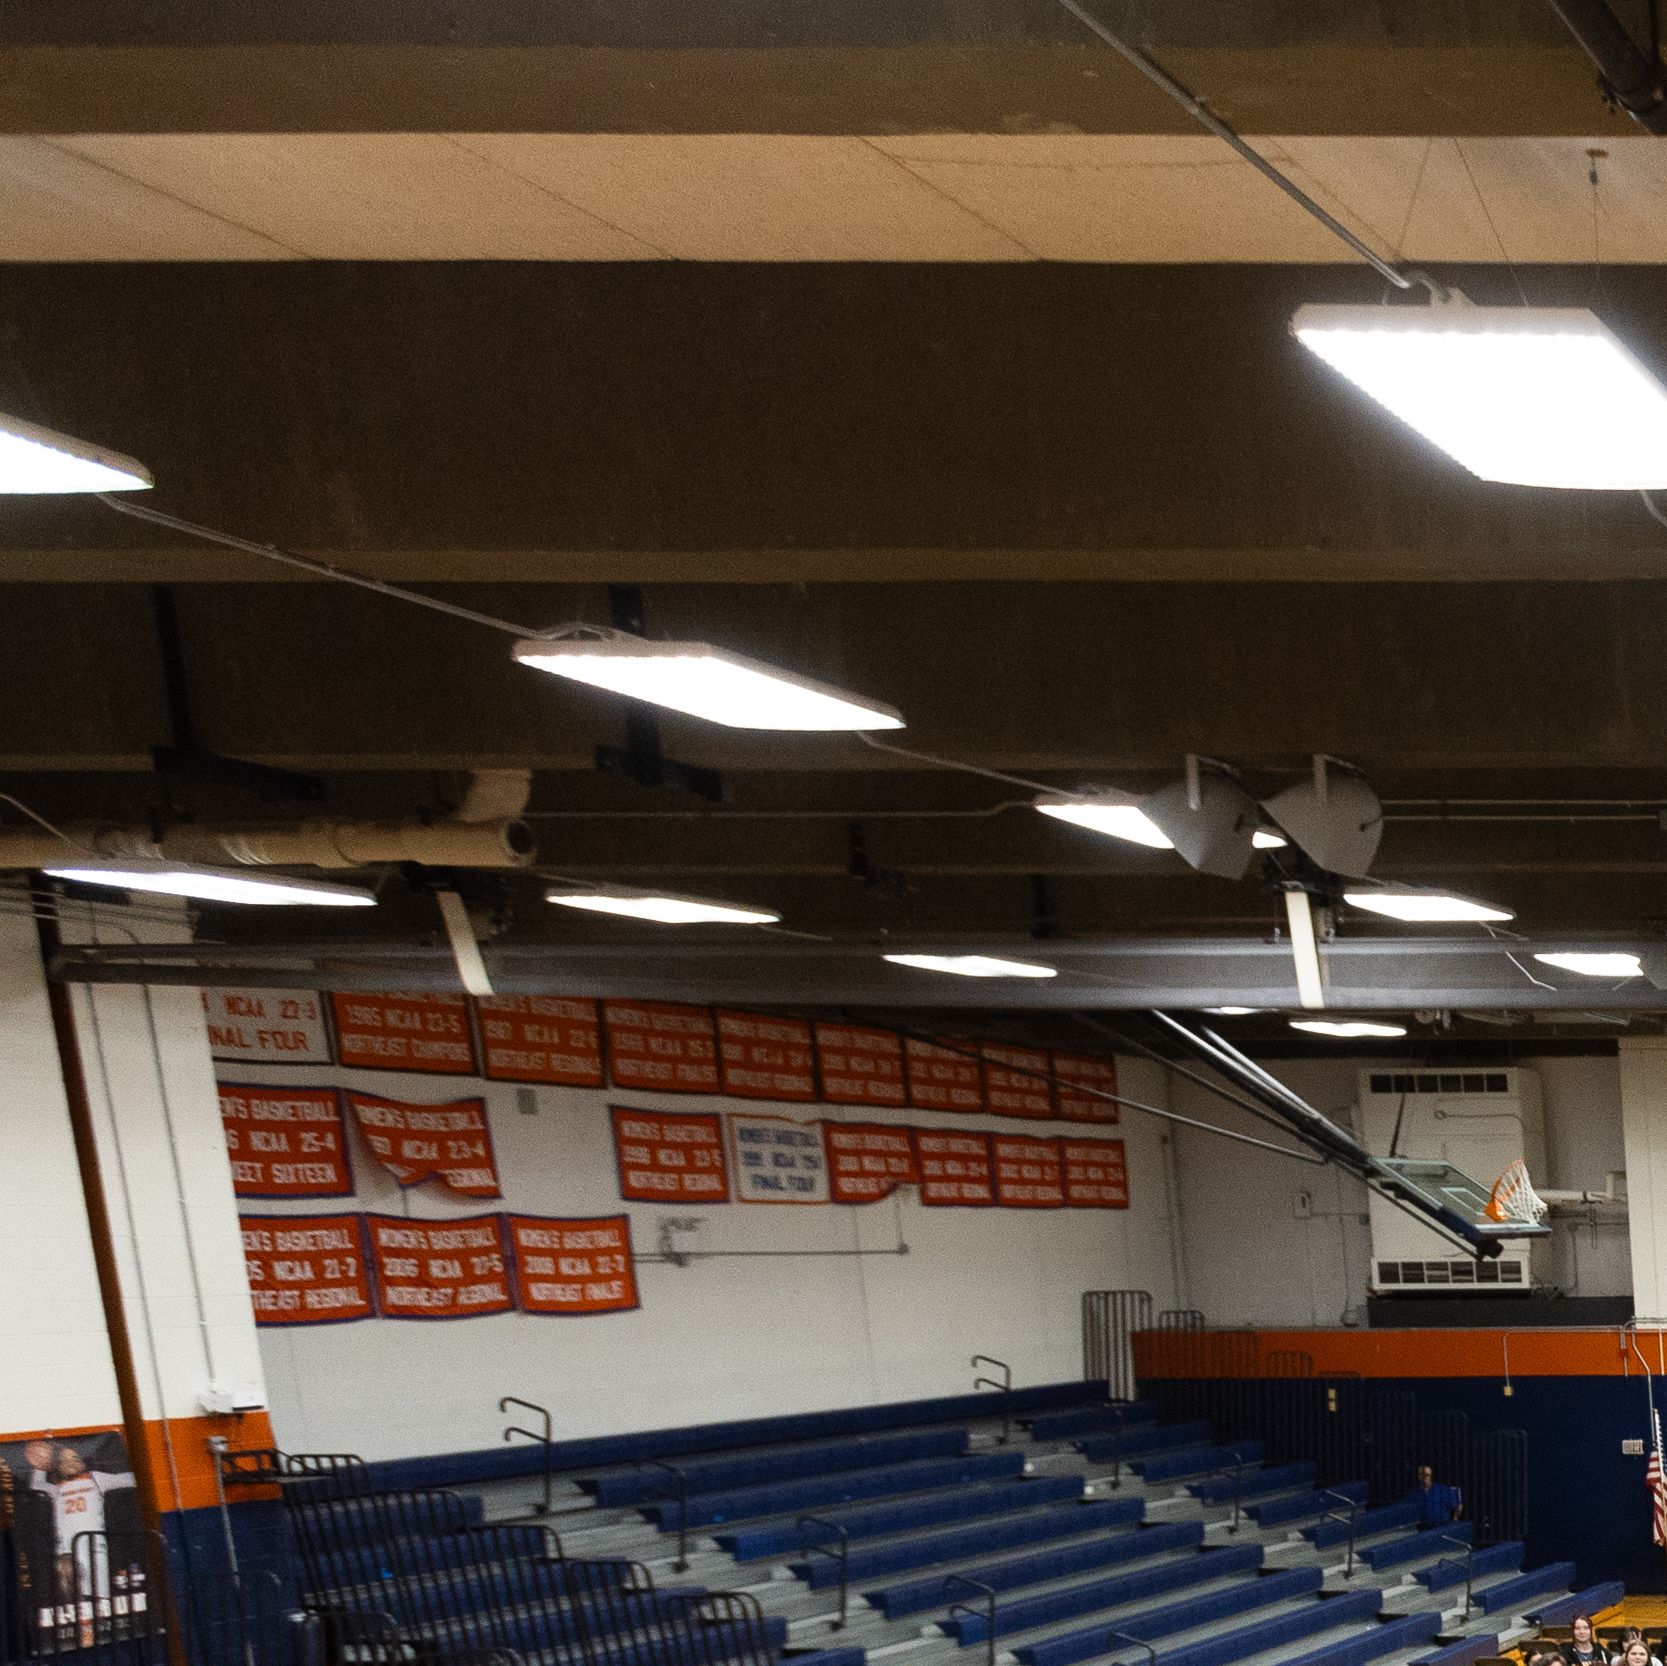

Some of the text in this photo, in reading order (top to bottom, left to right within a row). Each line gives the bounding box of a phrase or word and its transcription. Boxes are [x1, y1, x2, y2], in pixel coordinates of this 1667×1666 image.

[257, 1029, 309, 1051] FOUR
[250, 1098, 341, 1121] BASKETBALL
[405, 1111, 486, 1131] BASKETBALL
[250, 1130, 290, 1152] NCAA
[402, 1140, 439, 1160] NCAA
[271, 1163, 338, 1184] SIXTEEN
[275, 1228, 355, 1252] BASKETBALL
[377, 1227, 497, 1251] WOMEN'S BASKETBALL
[516, 1227, 621, 1250] WOMEN'S BASKETBALL
[272, 1259, 314, 1281] NCAA
[427, 1259, 464, 1279] NCAA
[558, 1257, 592, 1276] NCAA
[304, 1286, 367, 1309] REGIONAL
[386, 1283, 509, 1309] NORTHEAST REGIONAL
